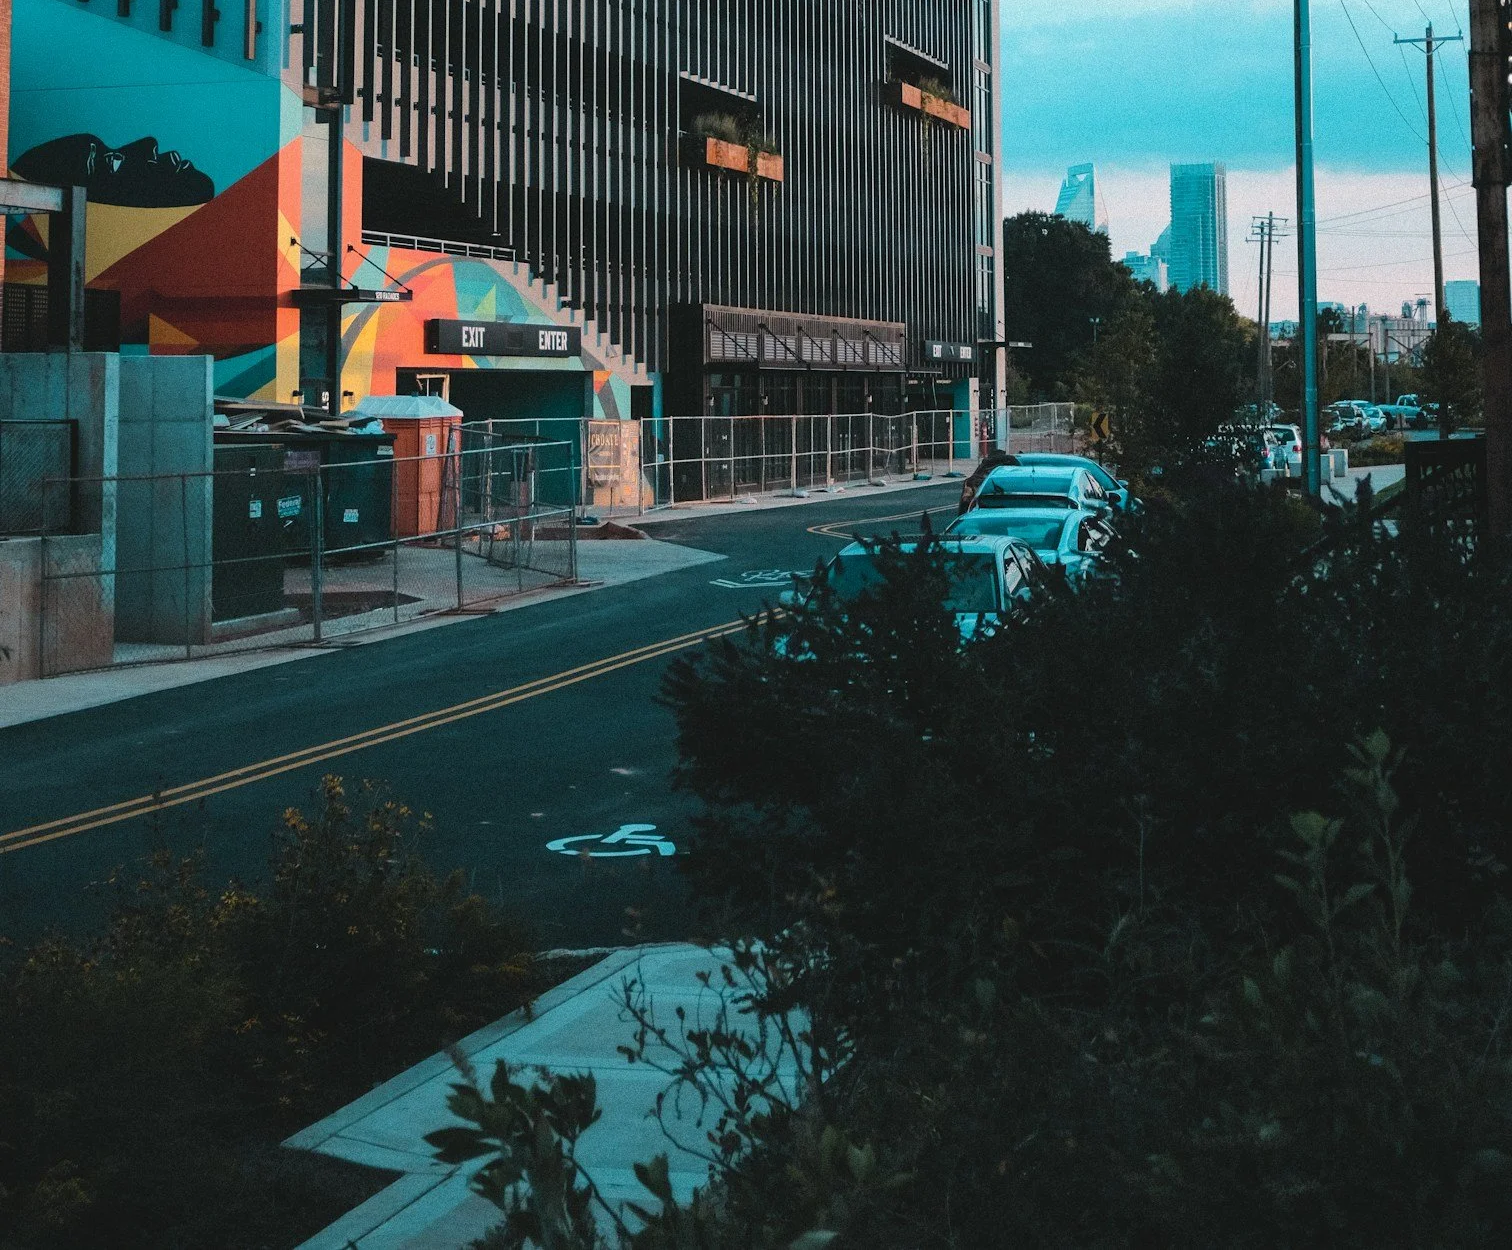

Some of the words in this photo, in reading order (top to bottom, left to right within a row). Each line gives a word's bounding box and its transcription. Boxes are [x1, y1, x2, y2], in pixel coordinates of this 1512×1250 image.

[462, 326, 486, 348] EXIT
[538, 330, 568, 351] ENTER
[591, 433, 618, 446] CHOATE
